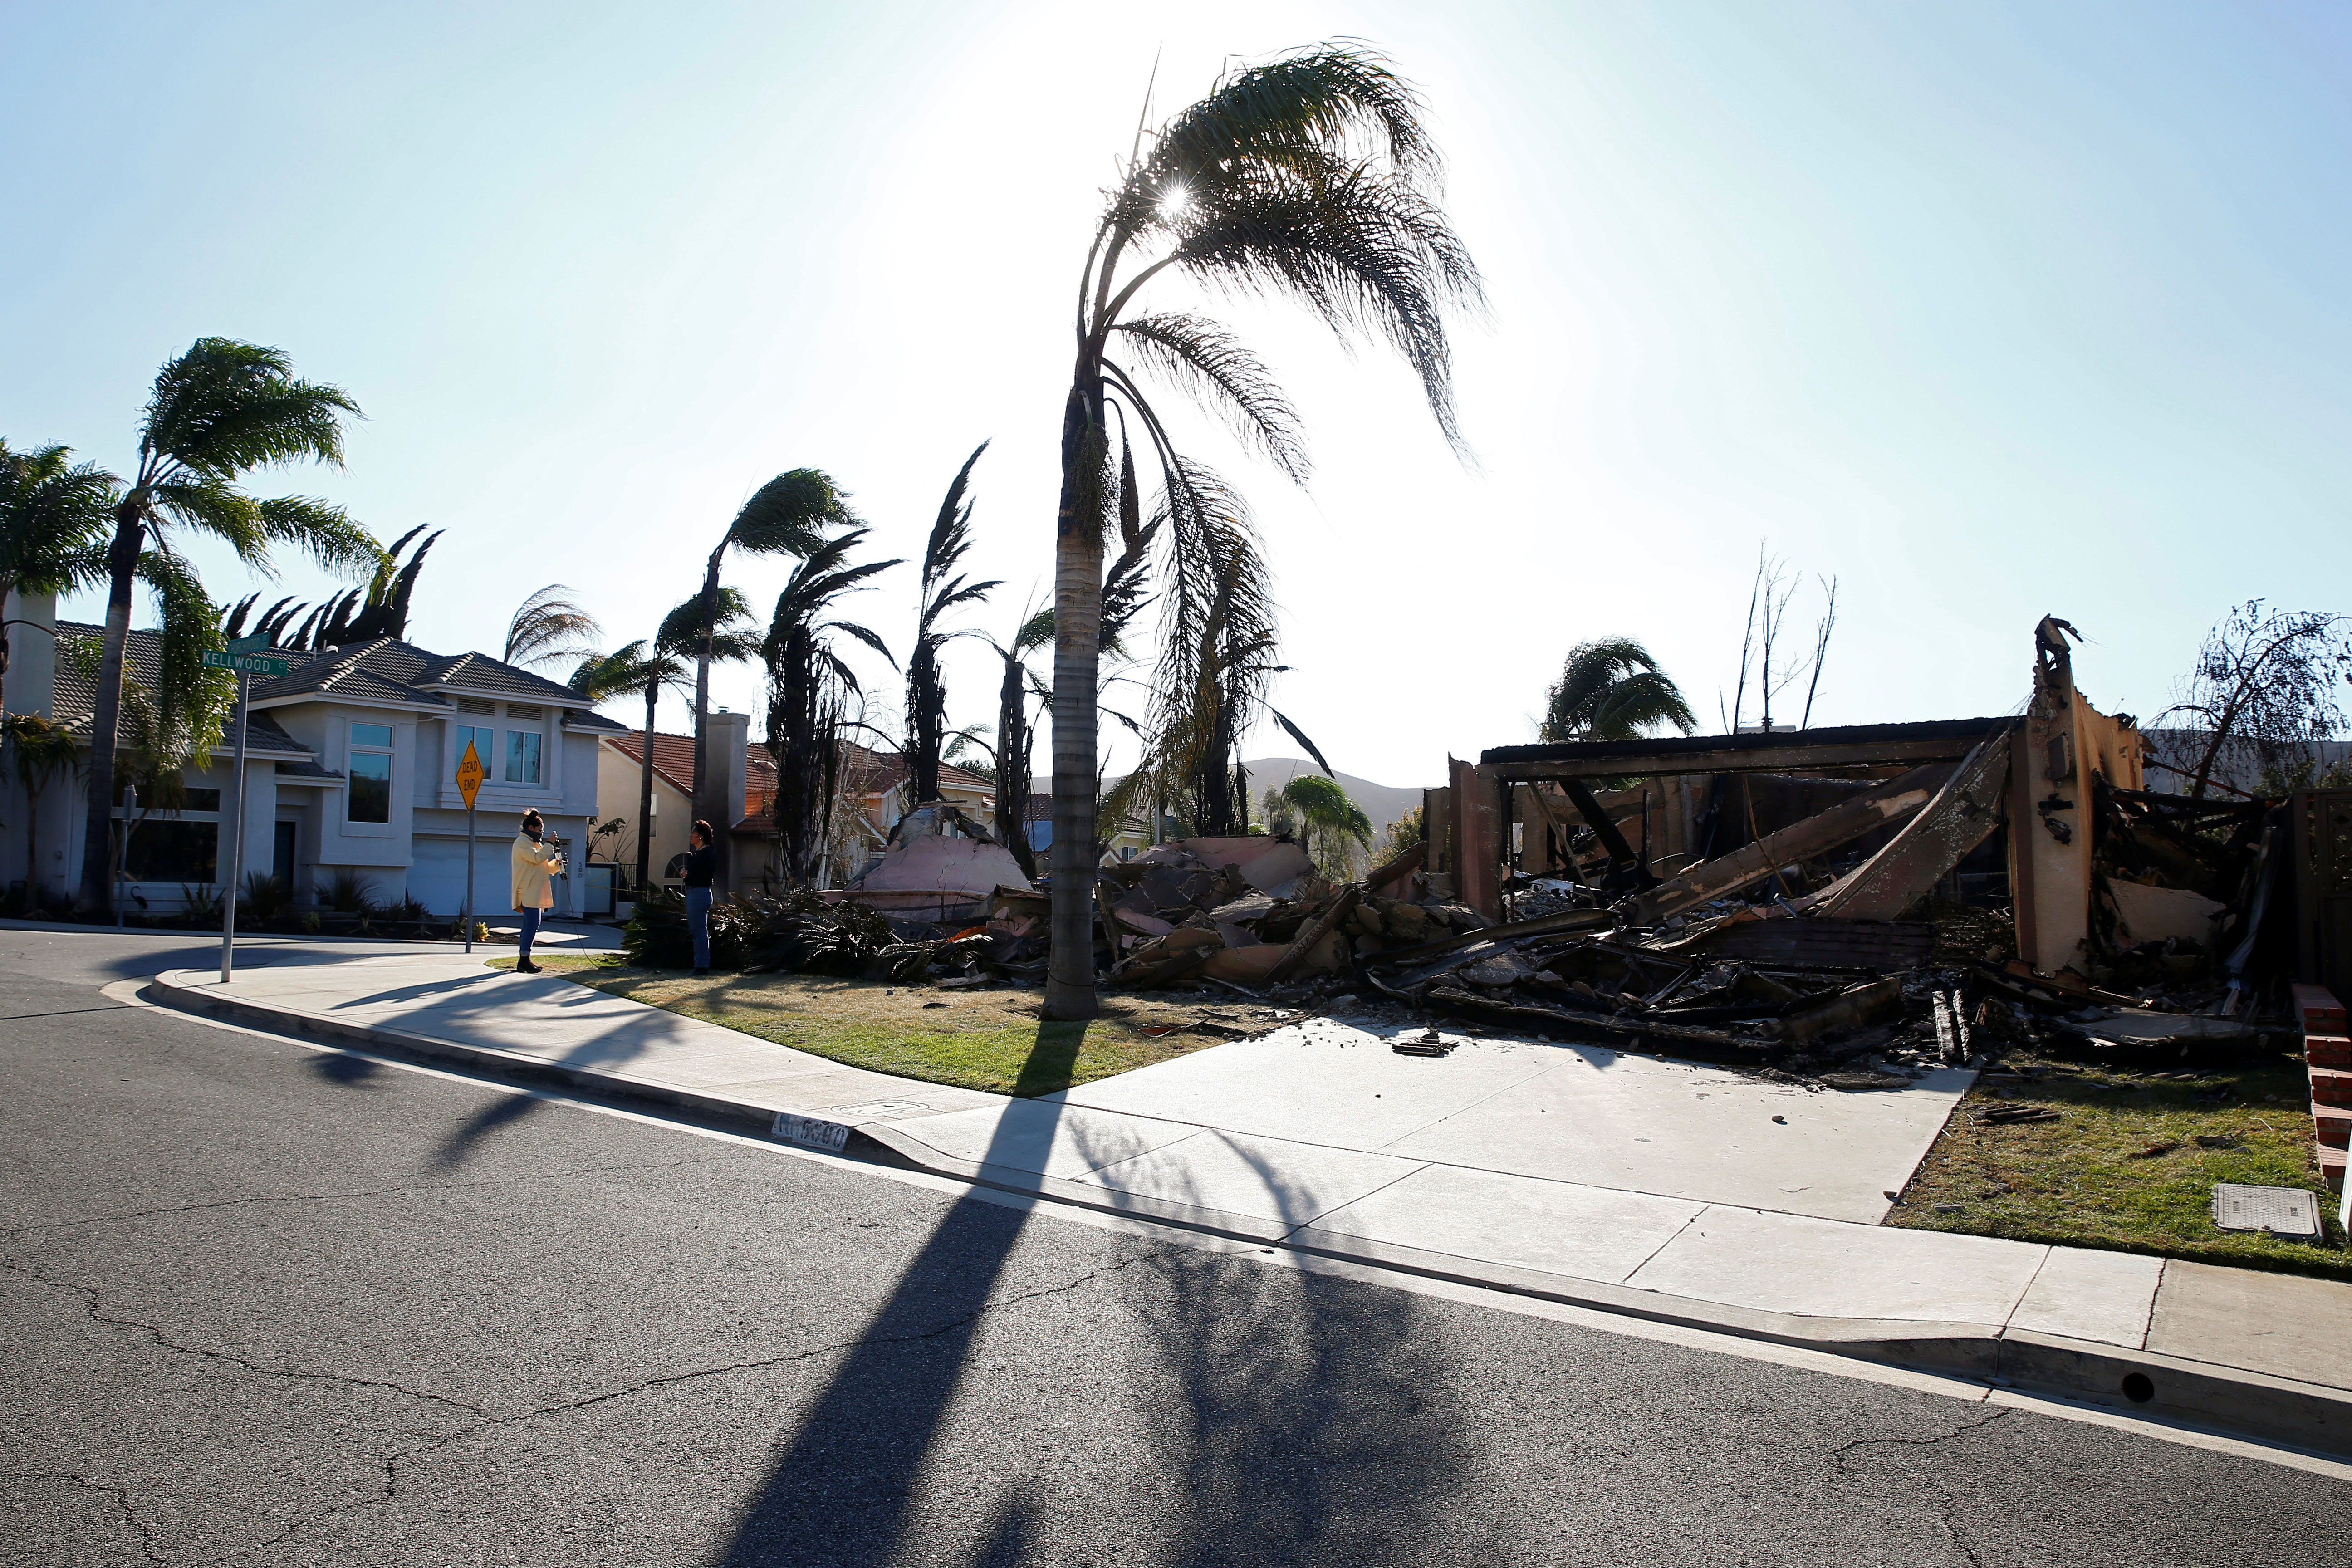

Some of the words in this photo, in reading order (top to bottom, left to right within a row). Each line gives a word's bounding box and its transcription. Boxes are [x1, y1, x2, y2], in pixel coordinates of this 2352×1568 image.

[203, 652, 270, 671] KELLWOOD
[462, 761, 477, 773] DEAD
[464, 779, 475, 791] END
